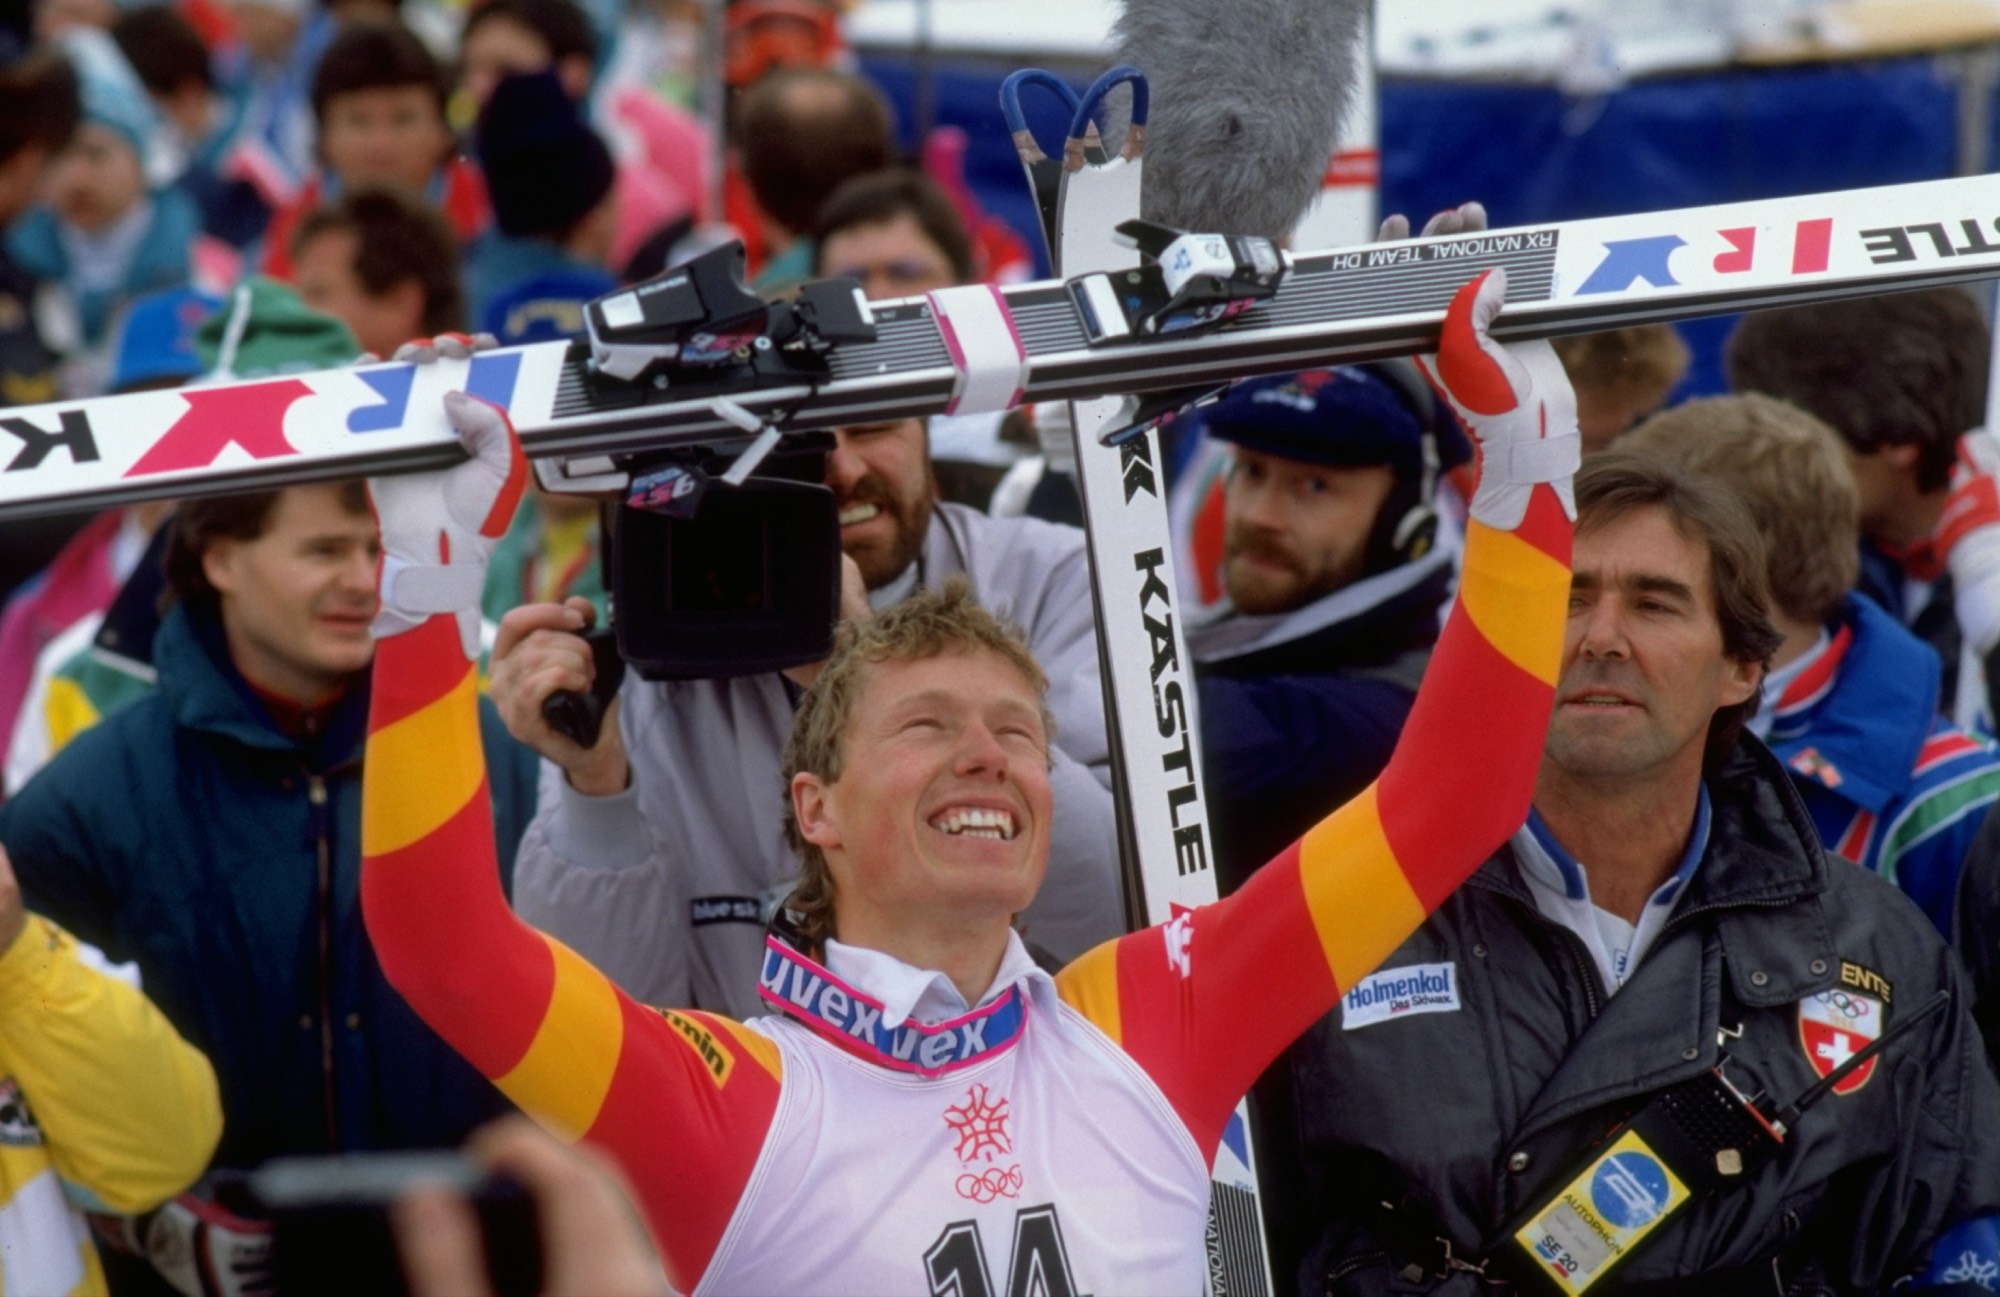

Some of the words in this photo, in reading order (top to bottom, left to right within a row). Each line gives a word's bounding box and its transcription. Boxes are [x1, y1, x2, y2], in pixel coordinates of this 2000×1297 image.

[1368, 247, 1423, 268] TEAM
[1428, 237, 1522, 260] NATIONAL
[1525, 232, 1553, 248] RX
[1858, 216, 2000, 265] TLE
[1332, 254, 1361, 271] DH
[1133, 546, 1208, 877] KASTLE
[760, 943, 884, 1047] uvex
[1347, 967, 1450, 1010] Holmenkol
[1840, 961, 1892, 1004] ENTE
[1563, 1193, 1624, 1256] AUTOPHON
[922, 1202, 1094, 1297] 14
[1205, 1213, 1227, 1297] NATIONA
[1540, 1234, 1563, 1257] SE
[1558, 1252, 1579, 1274] 20
